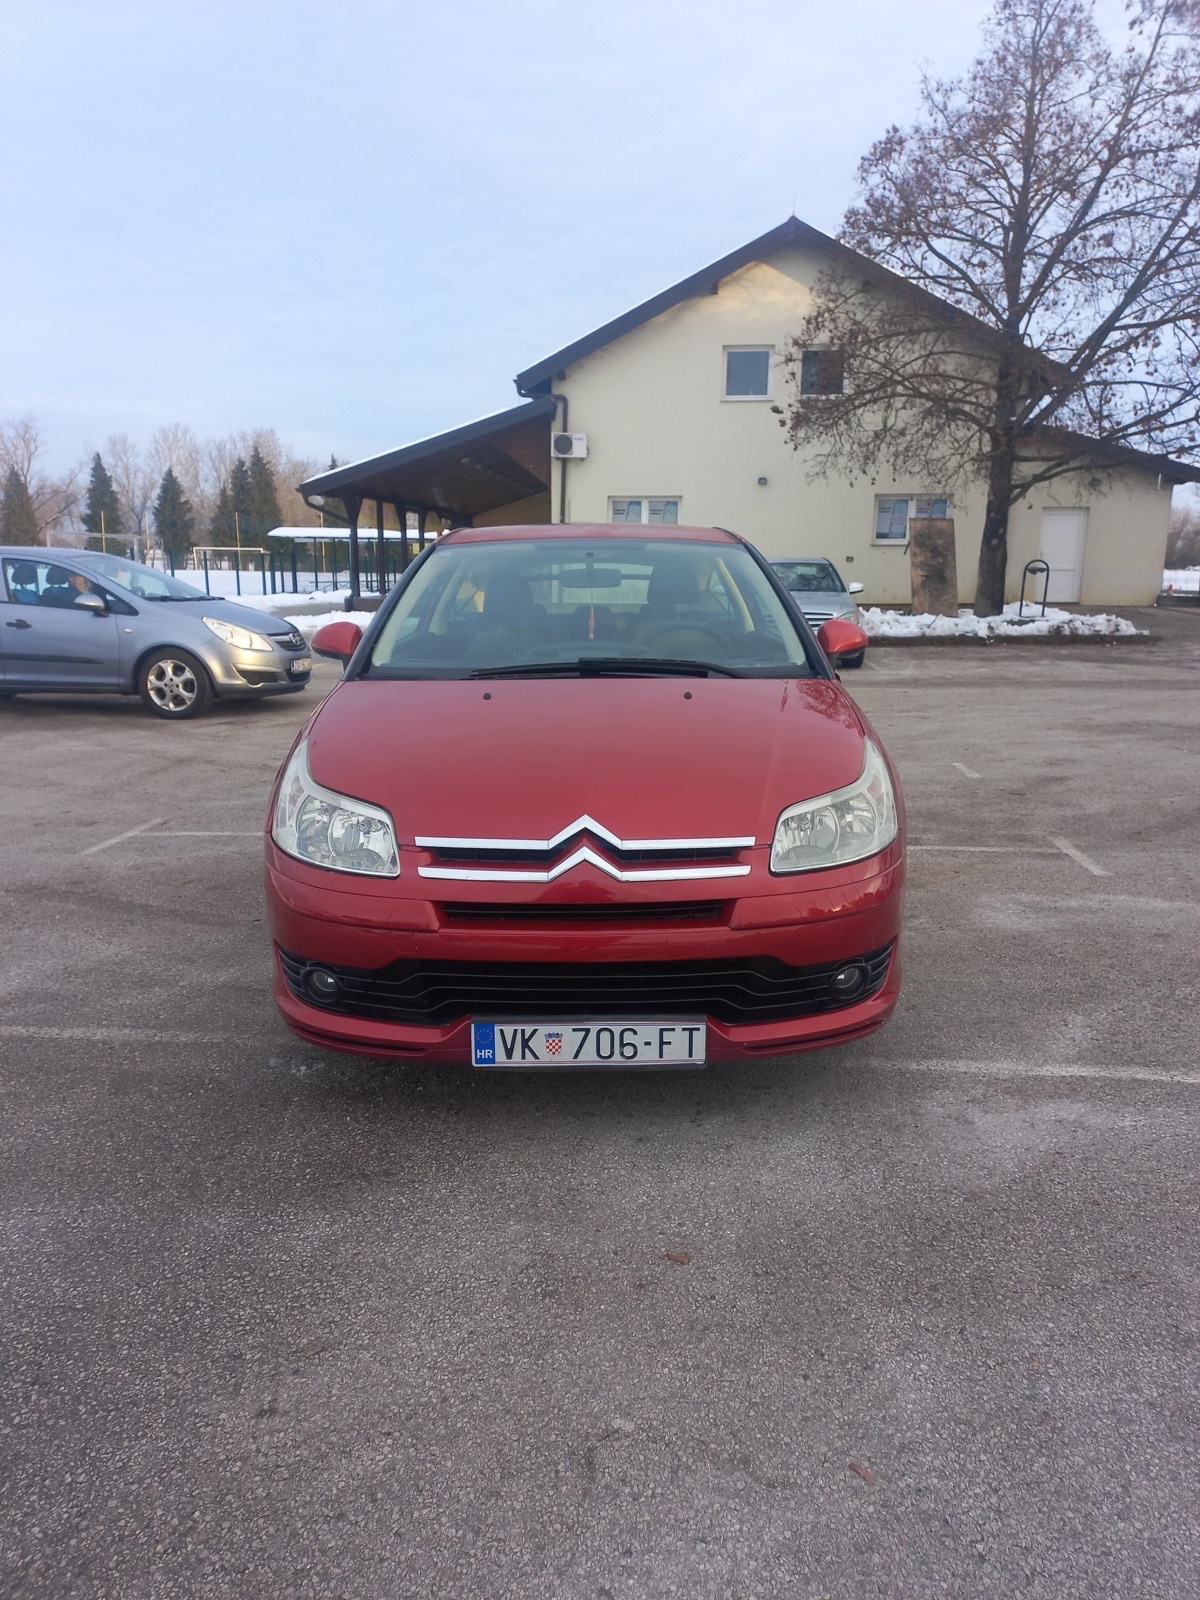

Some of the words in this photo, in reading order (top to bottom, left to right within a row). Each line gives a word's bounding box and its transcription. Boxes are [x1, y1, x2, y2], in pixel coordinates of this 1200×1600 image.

[499, 1028, 541, 1060] VK
[571, 1027, 701, 1060] 706-FT
[477, 1050, 493, 1059] HR
